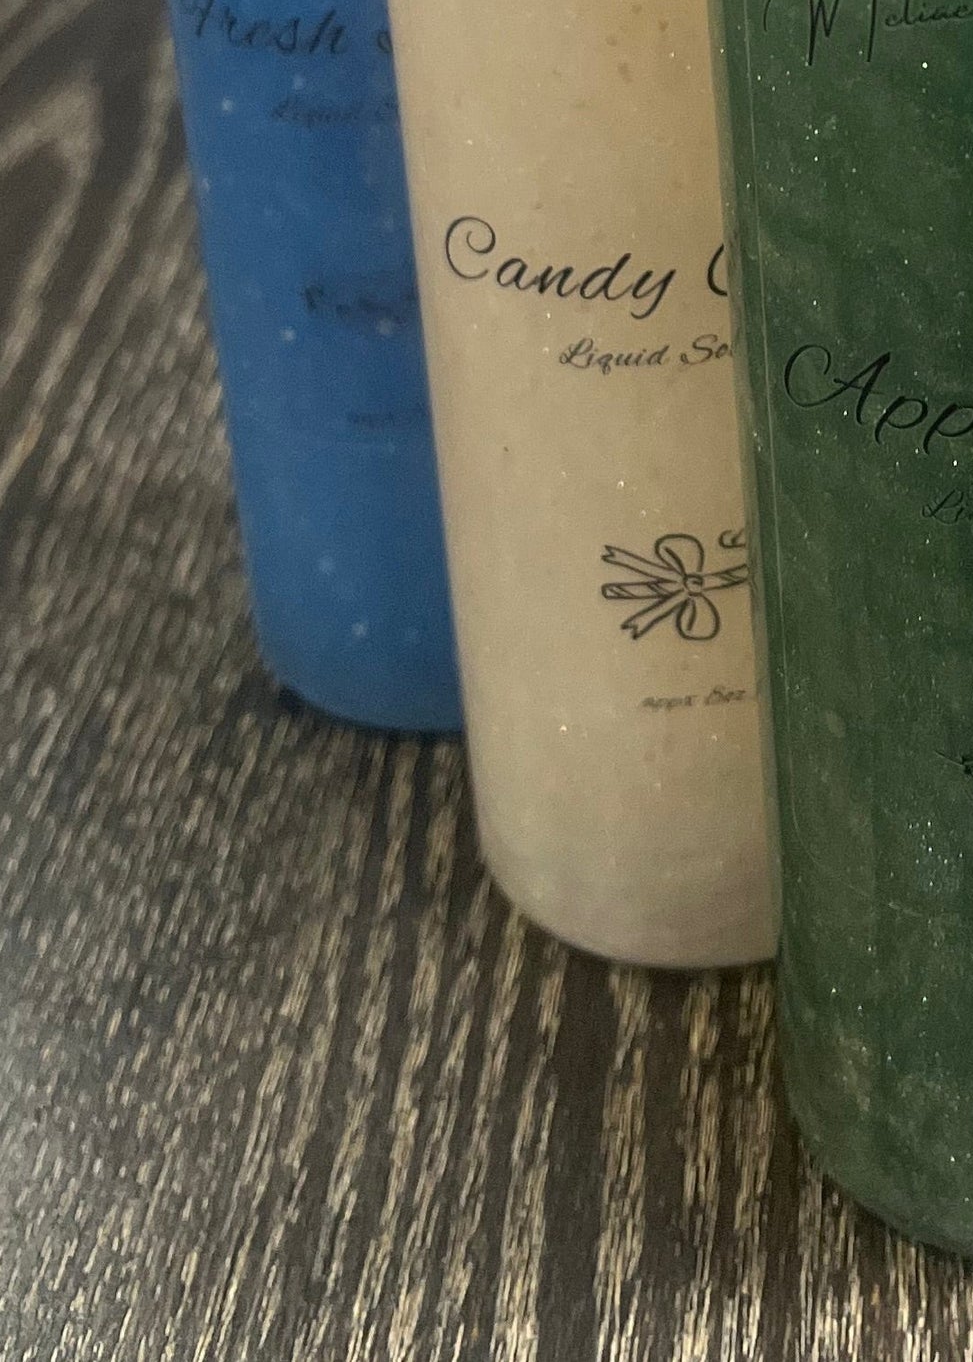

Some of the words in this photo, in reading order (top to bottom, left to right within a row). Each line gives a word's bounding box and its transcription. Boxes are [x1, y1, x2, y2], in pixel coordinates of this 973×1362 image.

[444, 215, 678, 320] Candy
[558, 337, 671, 376] Liquid
[679, 333, 732, 366] So
